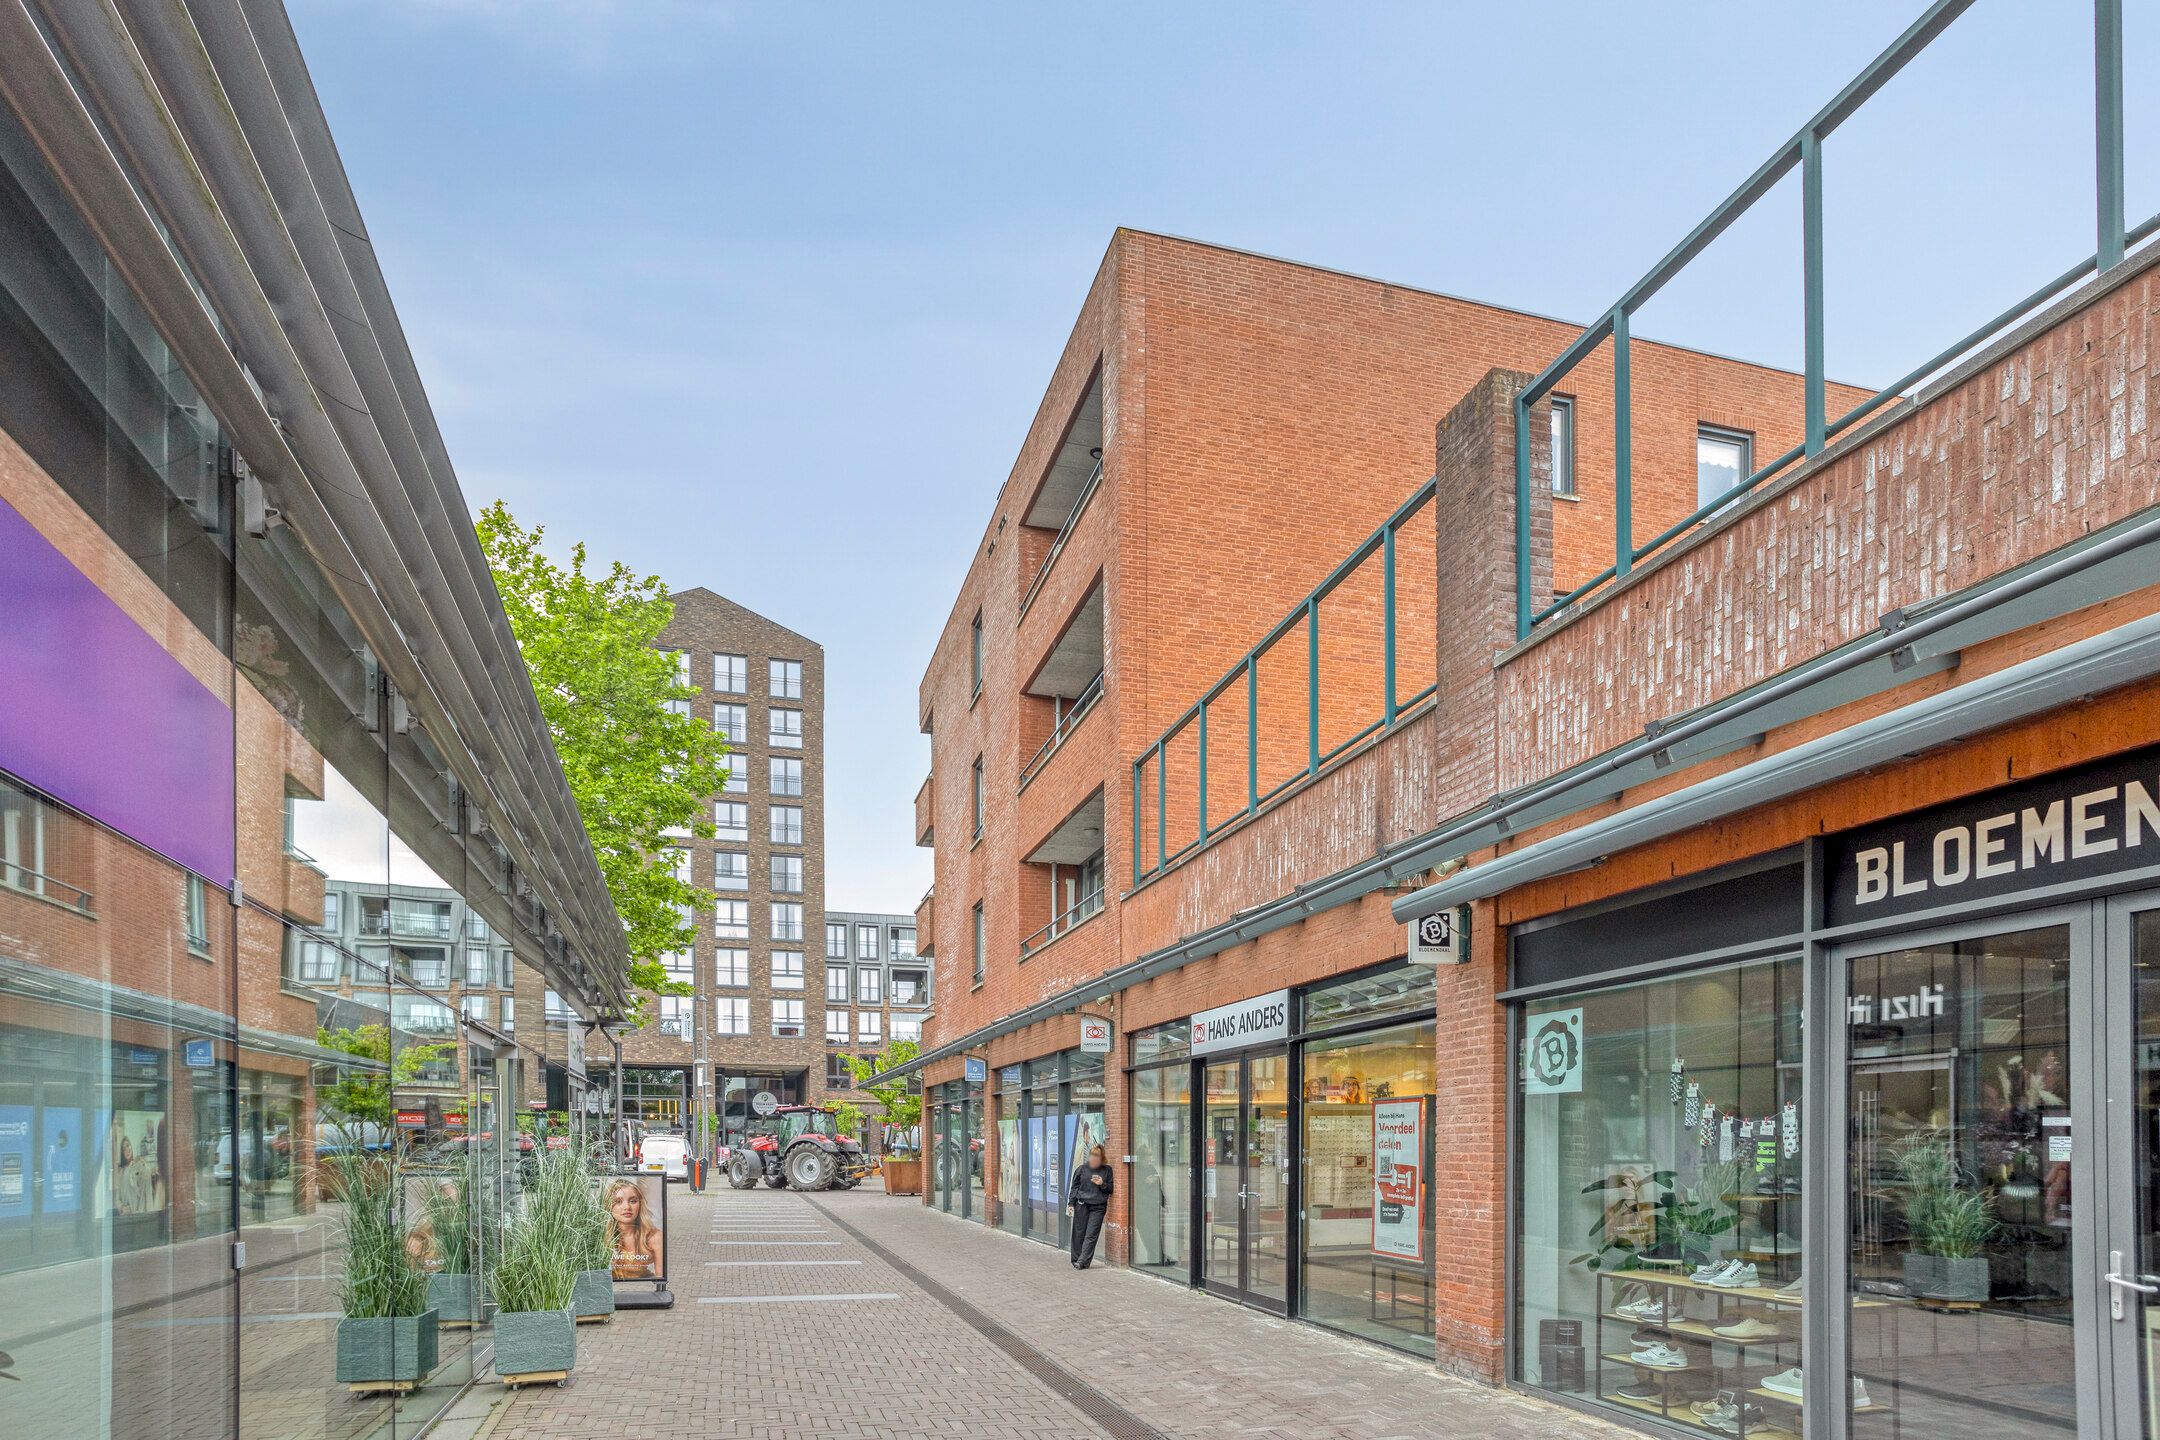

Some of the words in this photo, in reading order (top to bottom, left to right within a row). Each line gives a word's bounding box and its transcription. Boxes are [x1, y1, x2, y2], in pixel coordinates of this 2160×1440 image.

[1855, 780, 2160, 905] BLOEMEN
[1208, 1015, 1235, 1041] HANS
[1238, 1002, 1285, 1034] ANDERS
[1378, 1120, 1415, 1134] Voordeel
